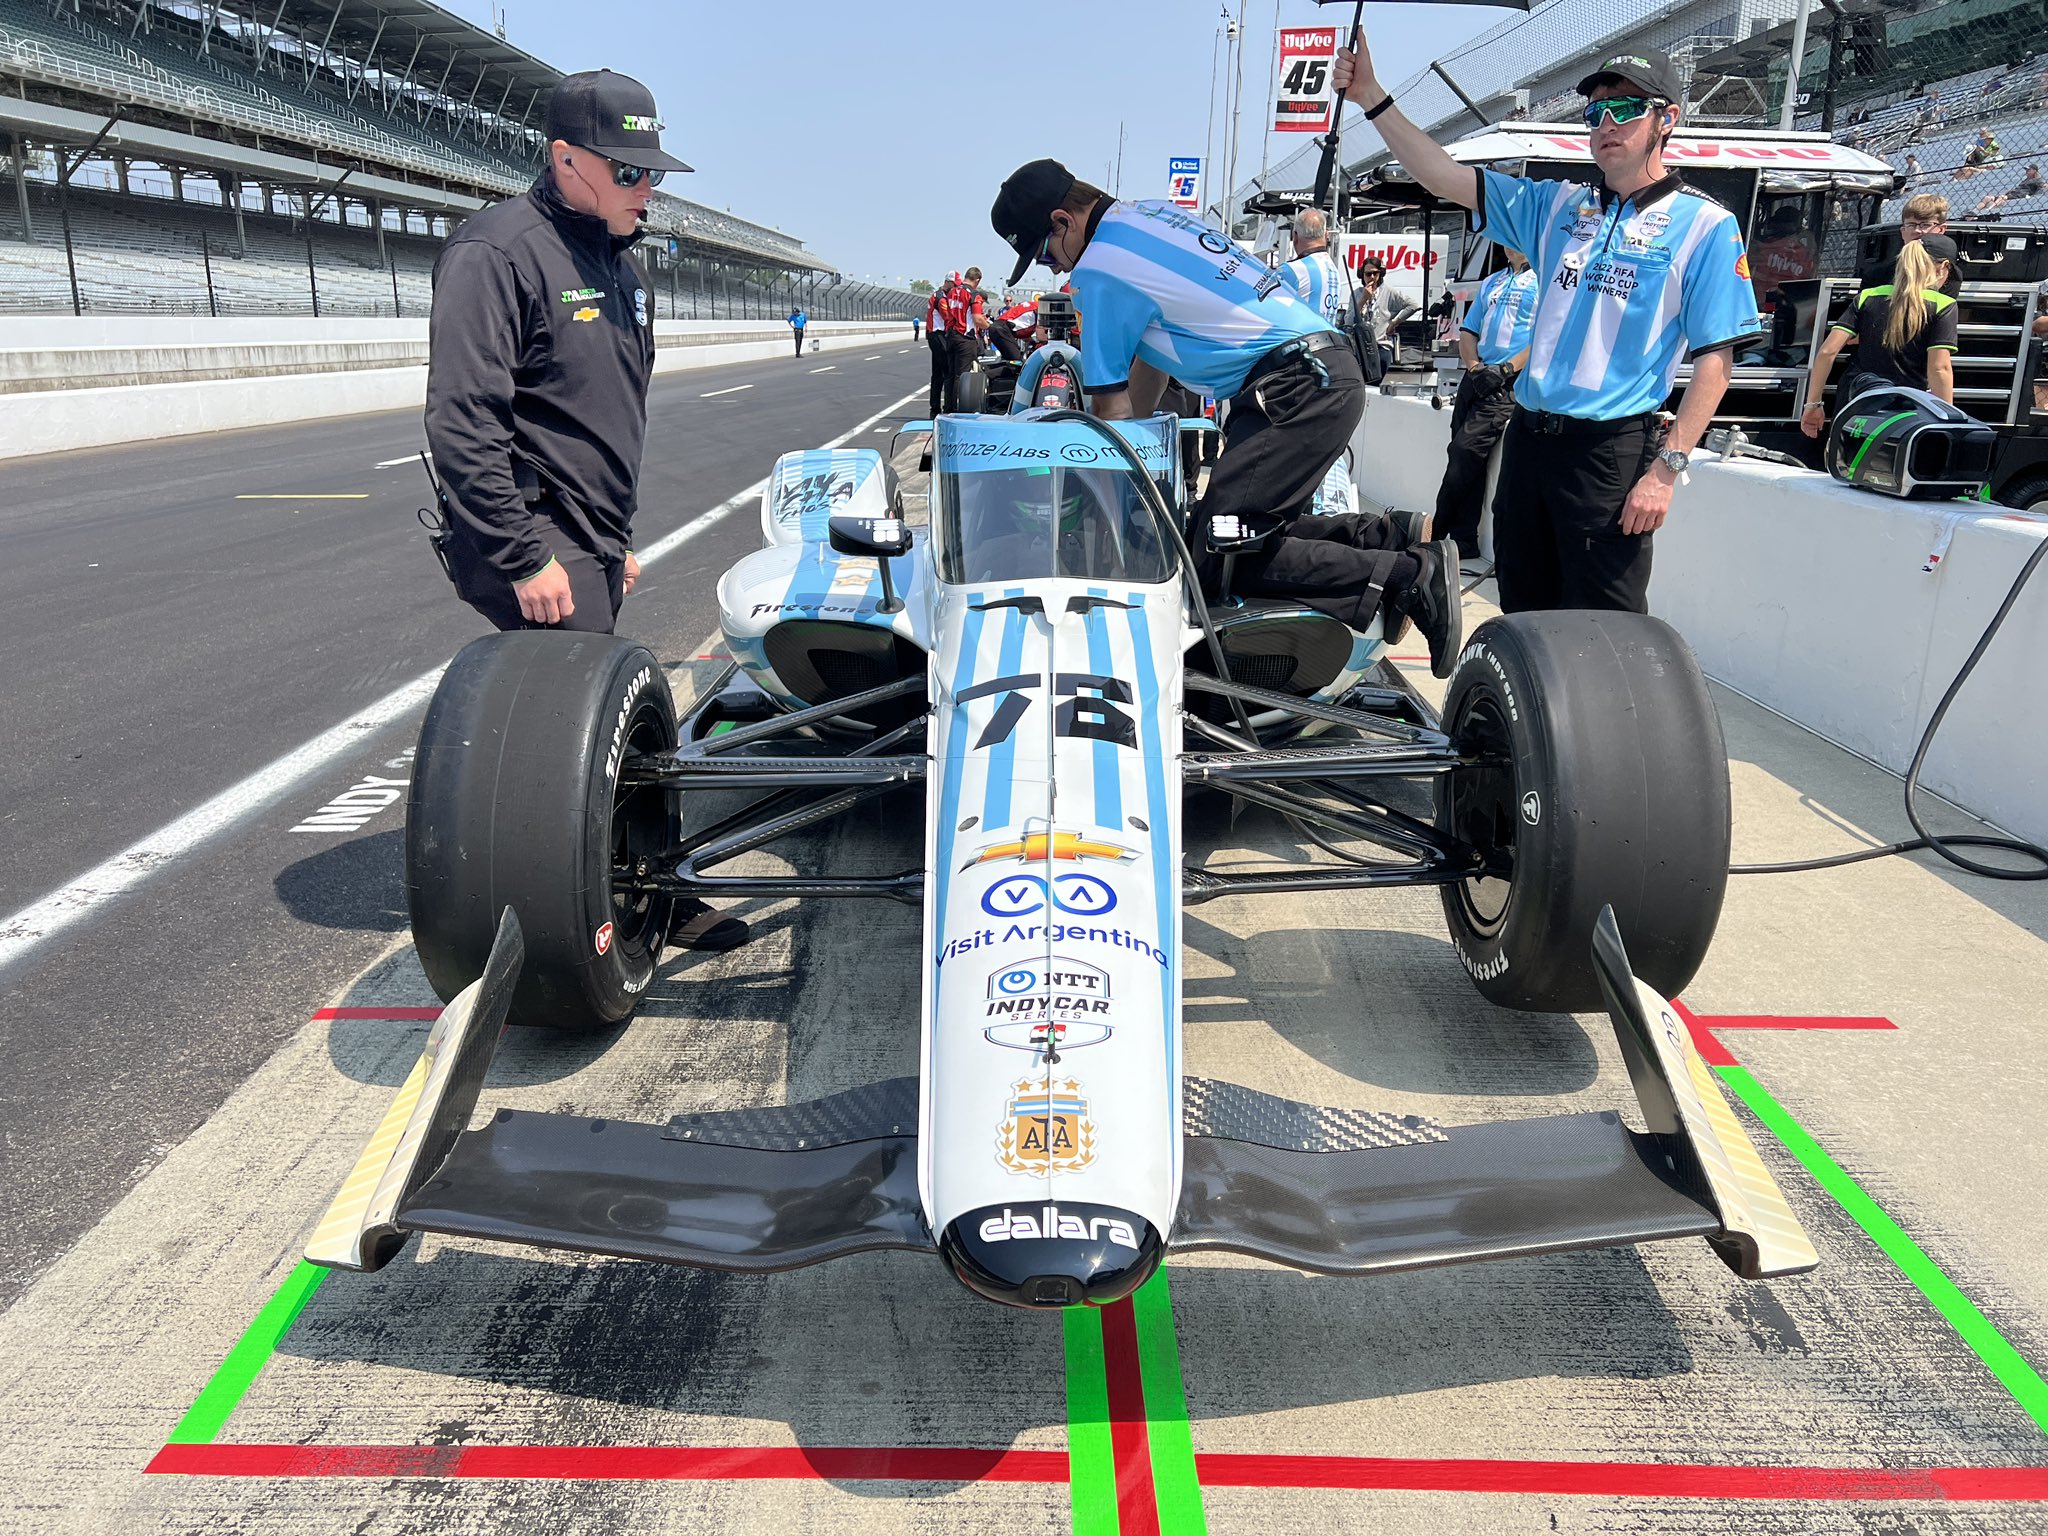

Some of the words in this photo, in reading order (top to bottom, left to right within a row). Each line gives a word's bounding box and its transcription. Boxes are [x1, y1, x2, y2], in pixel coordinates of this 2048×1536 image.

[1284, 33, 1332, 51] HyVee
[1283, 60, 1329, 95] 45
[1288, 101, 1319, 113] HyVee
[1173, 177, 1196, 197] 15
[1215, 259, 1241, 281] Visit
[1613, 266, 1635, 279] FIFA
[1585, 271, 1616, 285] WORLD
[1617, 279, 1639, 290] CUP
[750, 602, 872, 619] Firestone
[1503, 681, 1519, 722] 500
[605, 666, 651, 779] Firestone
[288, 775, 411, 833] INDY
[936, 929, 995, 968] Visit
[1002, 924, 1169, 970] Argentina
[1043, 972, 1100, 989] NTT
[986, 996, 1110, 1017] INDYCAR
[1010, 1011, 1083, 1021] SERIES
[979, 1206, 1139, 1250] dallara
